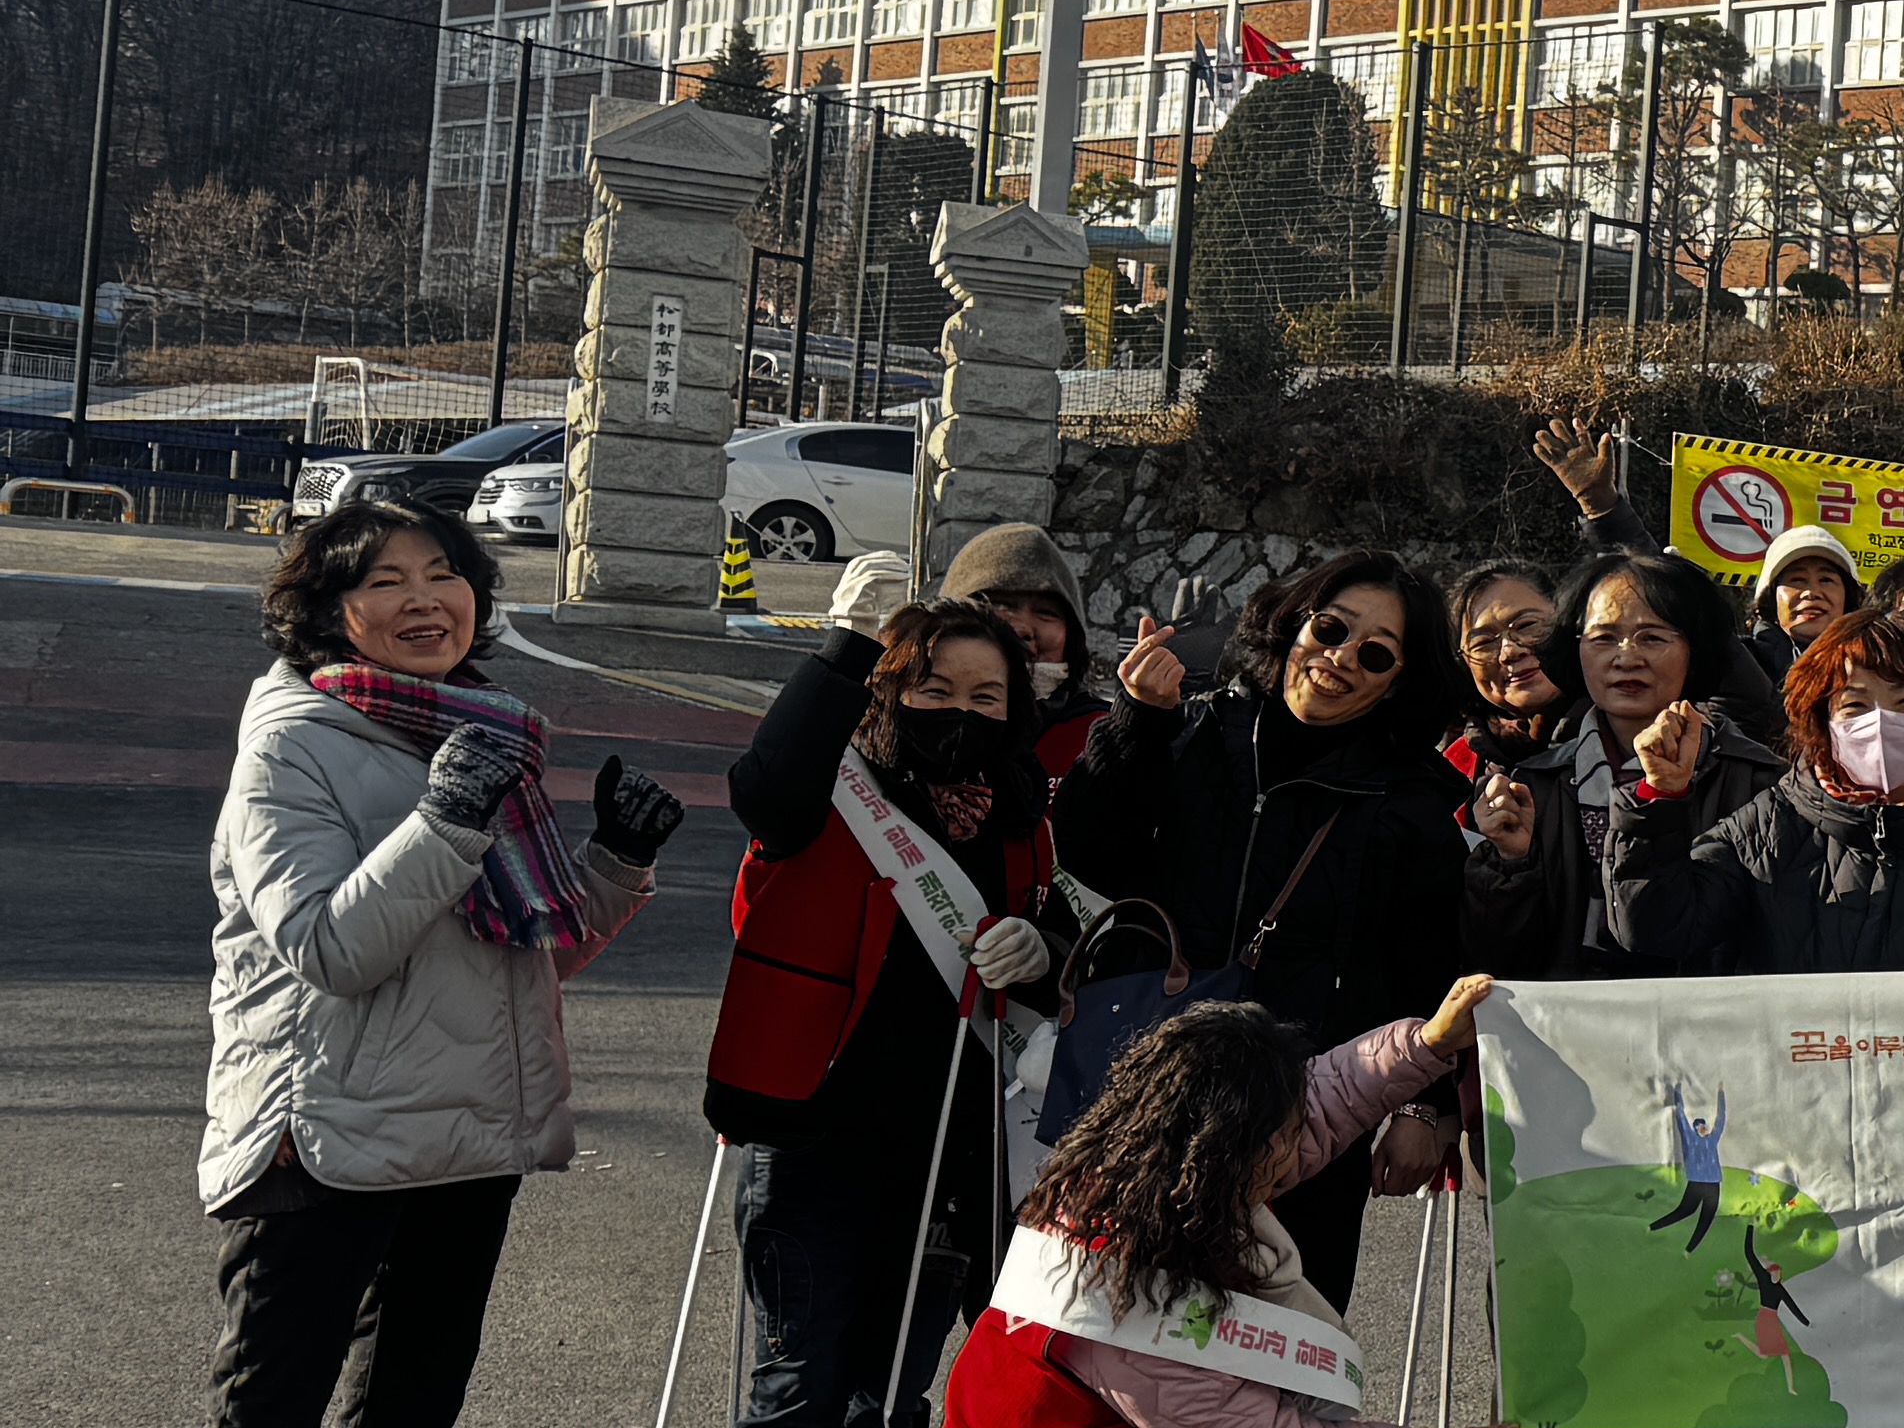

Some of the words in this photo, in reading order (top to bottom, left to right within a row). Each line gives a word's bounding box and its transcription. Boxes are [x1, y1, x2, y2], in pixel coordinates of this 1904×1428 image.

[882, 823, 926, 870] 함께
[1216, 1316, 1287, 1360] 주민과
[1294, 1337, 1337, 1375] 함께
